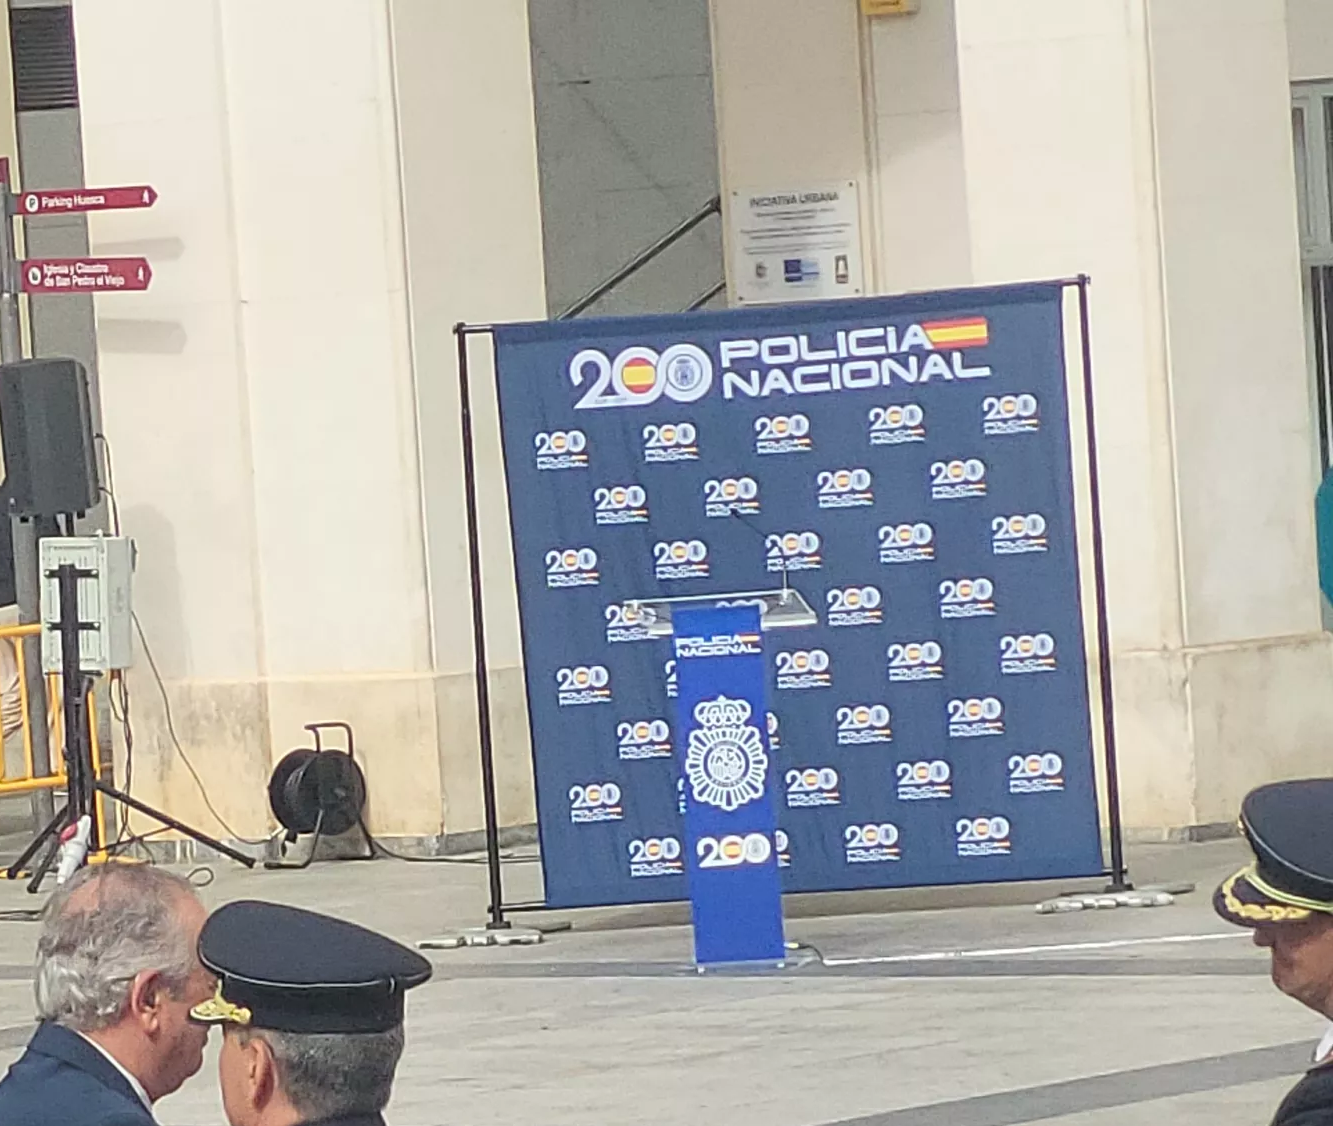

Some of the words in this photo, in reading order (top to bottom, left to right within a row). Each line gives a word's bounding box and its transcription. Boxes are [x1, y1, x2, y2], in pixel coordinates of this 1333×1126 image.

[41, 196, 72, 208] Parking
[720, 324, 934, 368] POLICIA
[570, 344, 712, 409] 200
[721, 352, 992, 399] NACIONAL
[869, 404, 922, 429] 200
[982, 394, 1037, 419] 200
[643, 423, 696, 447] 200
[755, 414, 808, 438] 200
[535, 431, 585, 455] 200
[817, 469, 870, 493] 200
[931, 459, 983, 484] 200
[594, 486, 644, 510] 200
[704, 477, 756, 501] 200
[879, 523, 931, 547] 200
[992, 514, 1044, 539] 200
[546, 548, 596, 572] 200
[654, 540, 706, 564] 200
[827, 587, 879, 611] 200
[939, 578, 993, 603] 200
[676, 643, 761, 658] NACIONAL
[888, 642, 940, 666] 200
[1000, 634, 1053, 658] 200
[776, 650, 828, 674] 200
[557, 666, 608, 690] 200
[837, 705, 889, 729] 200
[948, 697, 1001, 721] 200
[617, 720, 668, 744] 200
[897, 761, 948, 785] 200
[1008, 753, 1061, 778] 200
[786, 768, 837, 792] 200
[569, 783, 619, 808] 200
[845, 824, 897, 848] 200
[956, 817, 1007, 841] 200
[629, 838, 680, 862] 200
[696, 833, 771, 868] 200
